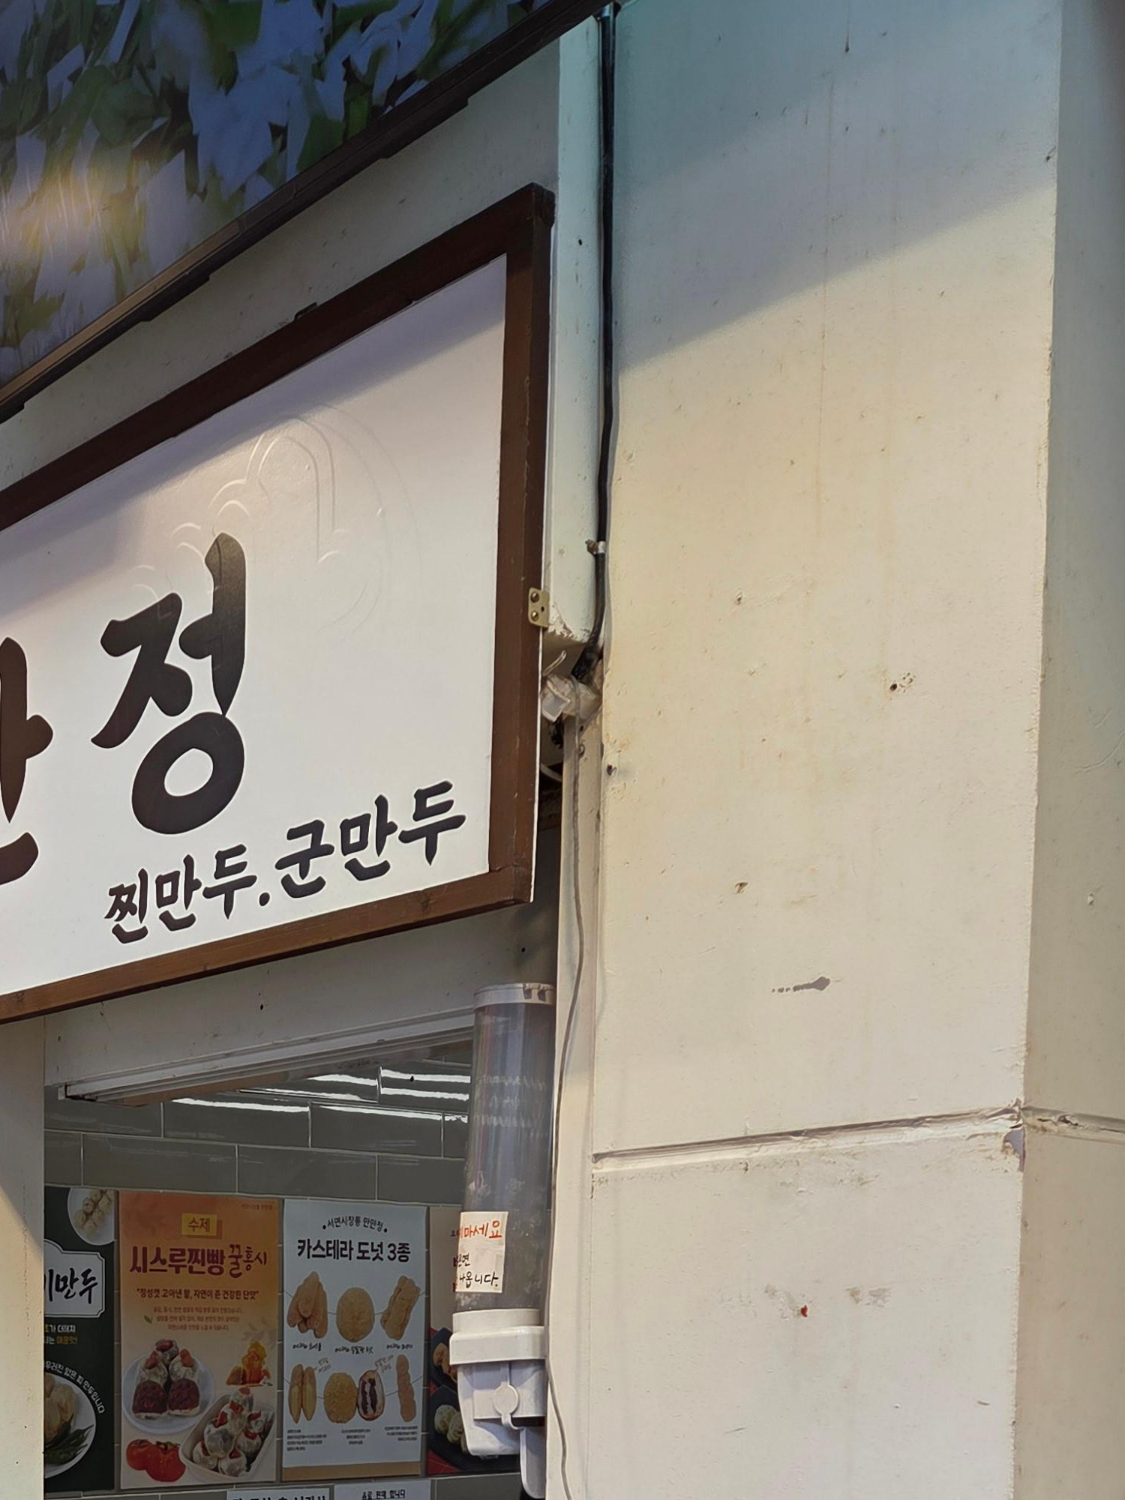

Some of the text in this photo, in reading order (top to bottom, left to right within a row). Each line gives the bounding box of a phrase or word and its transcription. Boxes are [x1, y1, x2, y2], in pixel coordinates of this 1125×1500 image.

[188, 1217, 210, 1233] 수제
[297, 1238, 411, 1263] 카스테라 도넛 3종
[129, 1244, 267, 1278] 시스루찐빵 꿀홍시
[223, 1290, 242, 1300] 건강한
